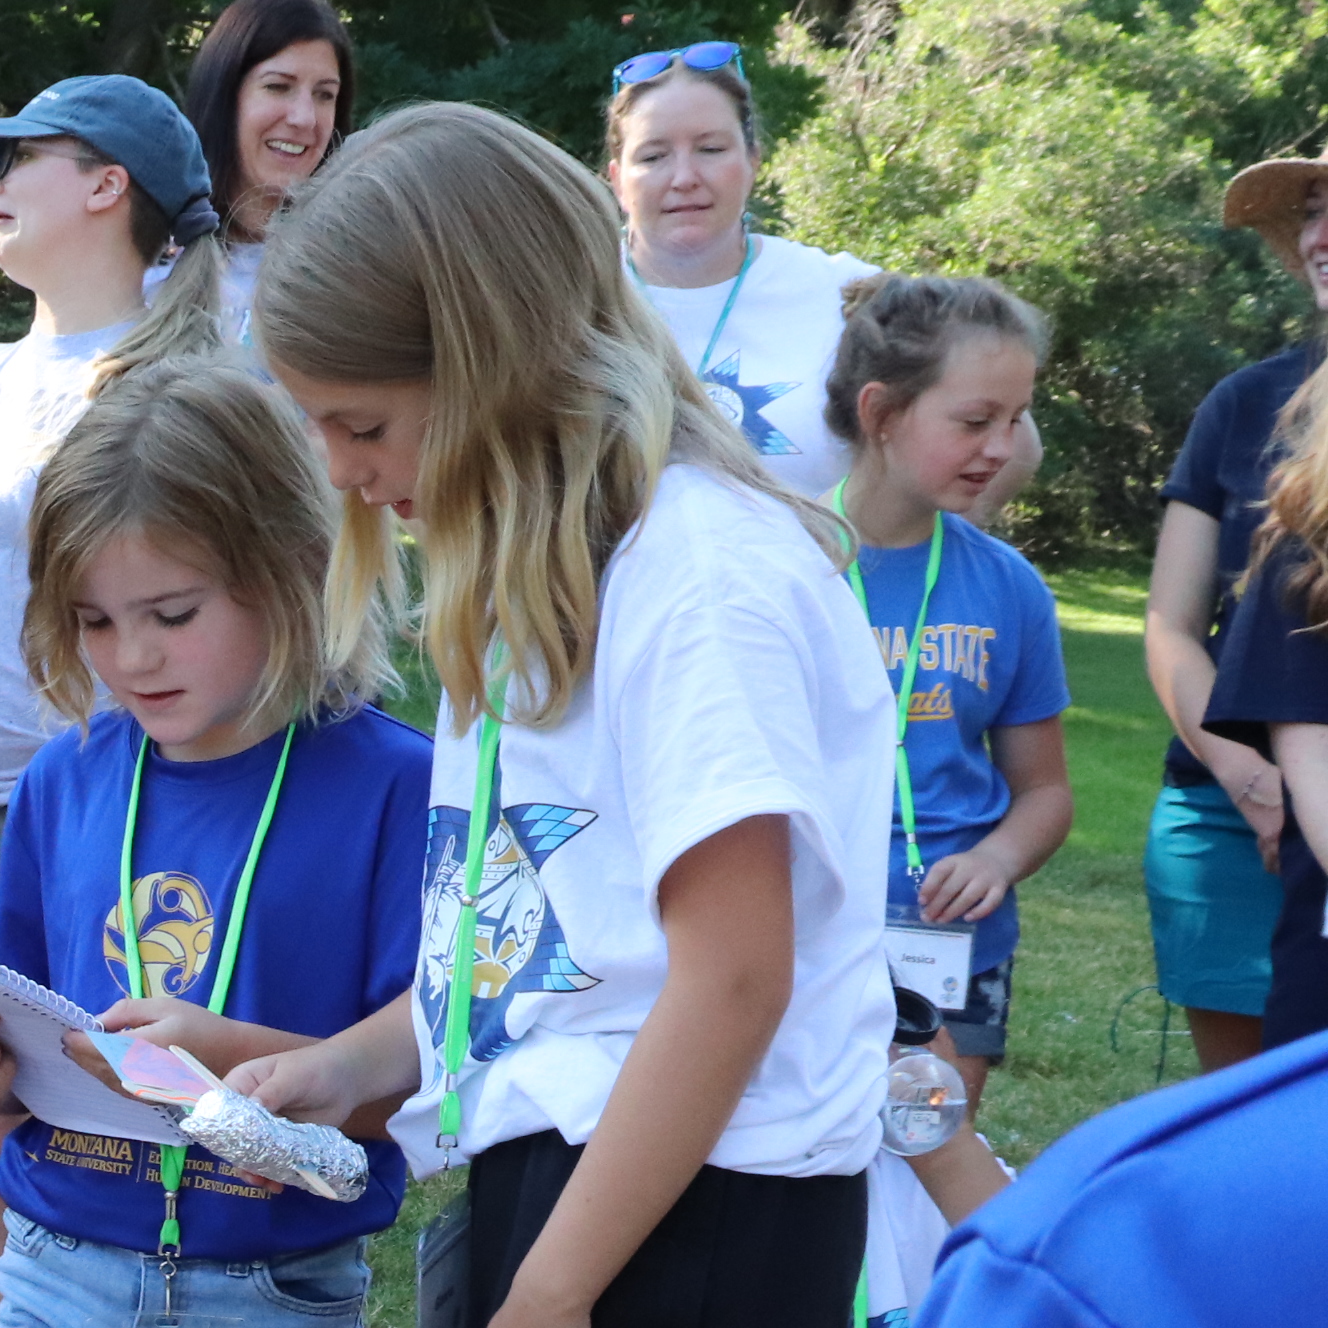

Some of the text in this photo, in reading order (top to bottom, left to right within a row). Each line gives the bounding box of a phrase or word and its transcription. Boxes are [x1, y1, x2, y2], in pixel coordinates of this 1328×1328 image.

[918, 622, 997, 692] STATE
[901, 953, 936, 965] Jessica
[45, 1149, 77, 1166] STATE
[49, 1129, 134, 1162] MONTANA
[148, 1151, 215, 1173] EDTION,
[145, 1168, 272, 1200] HUN DEVELOPMENT
